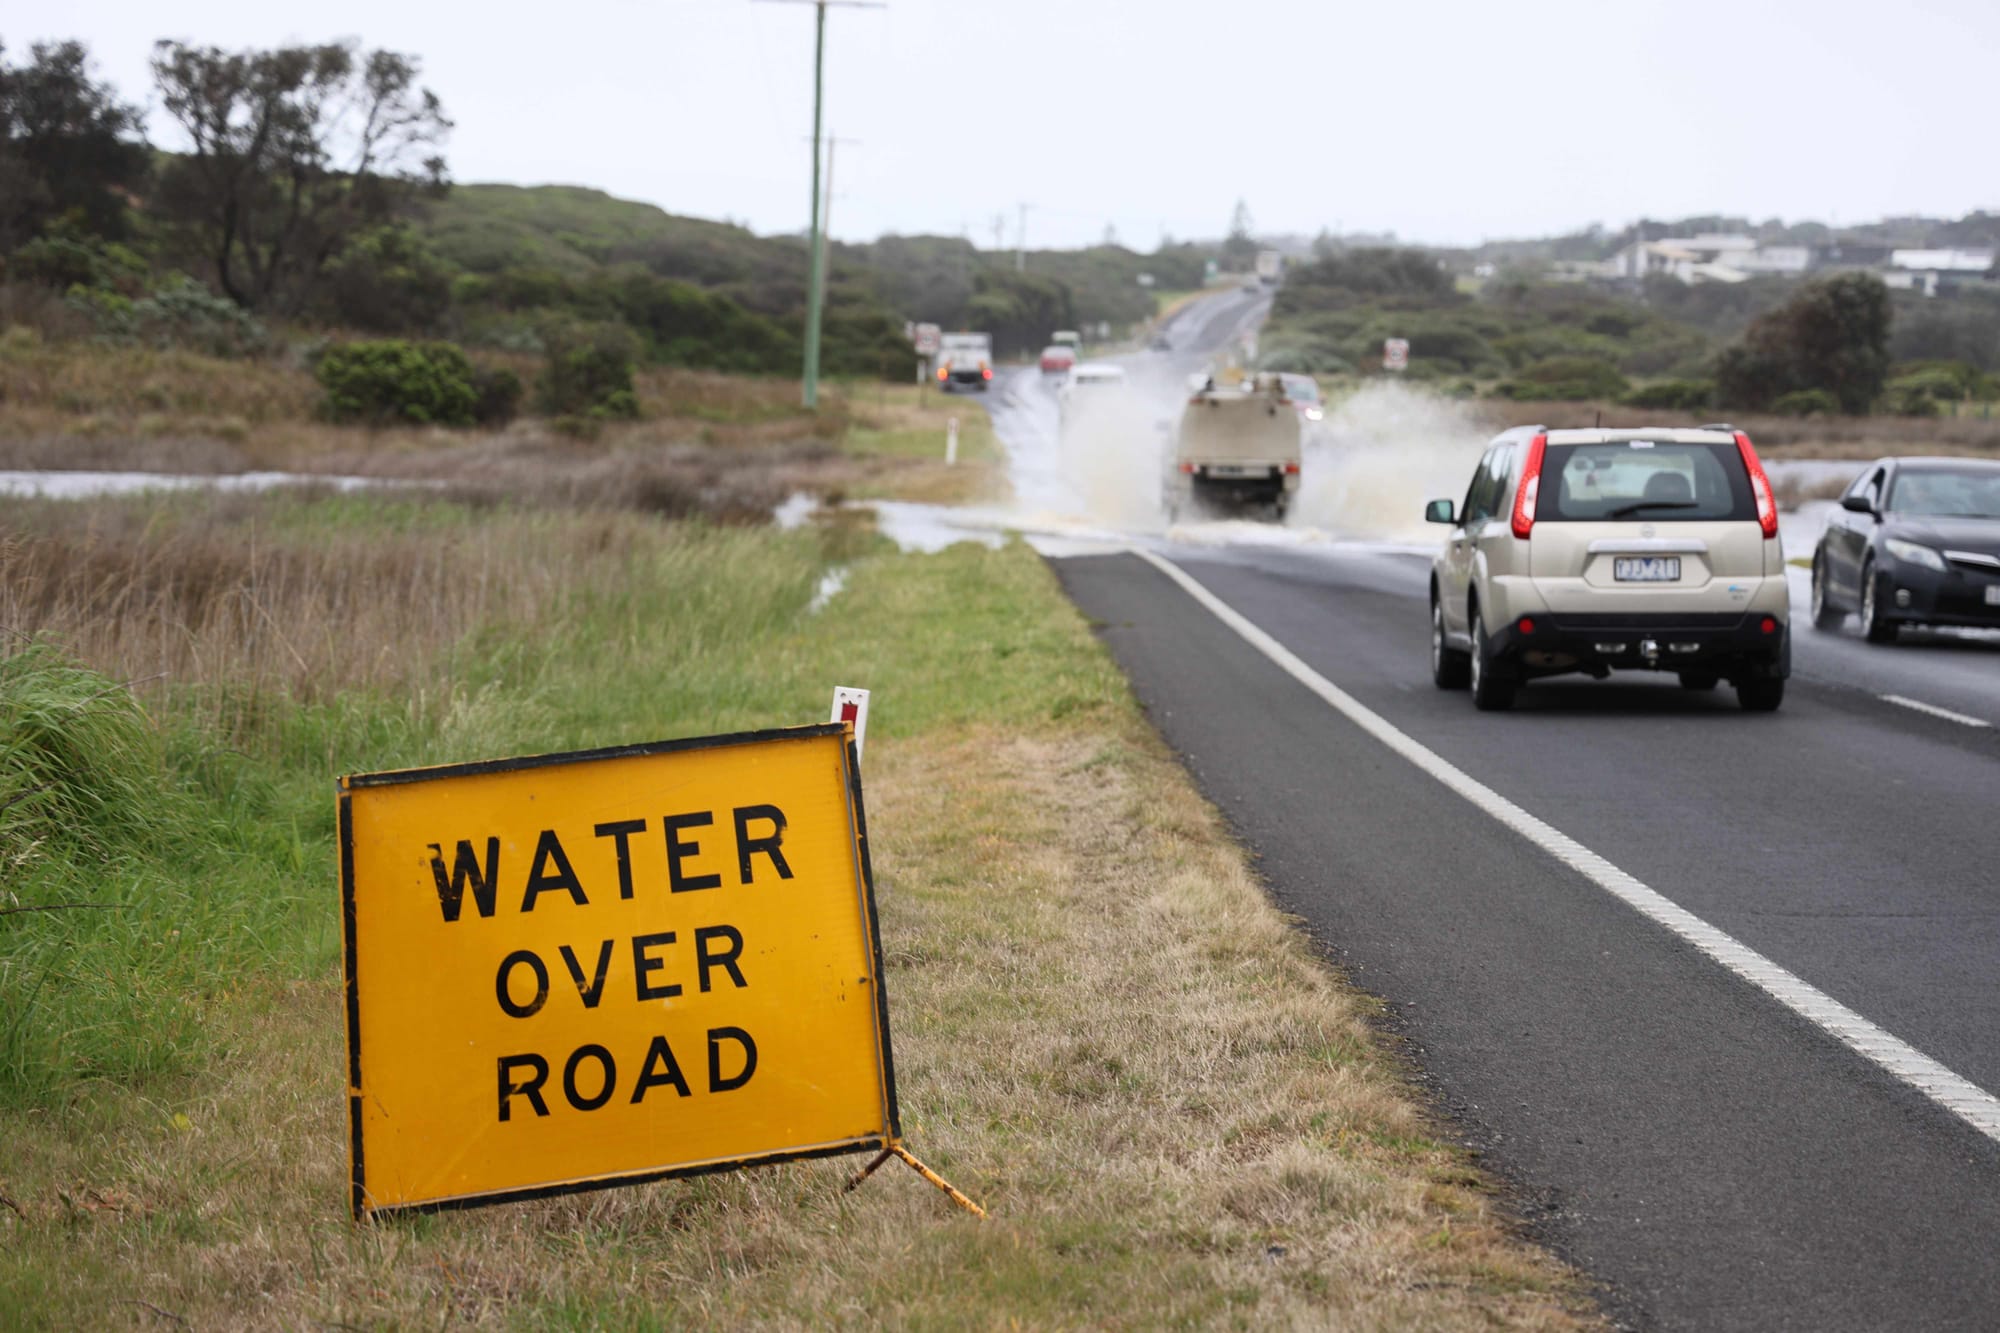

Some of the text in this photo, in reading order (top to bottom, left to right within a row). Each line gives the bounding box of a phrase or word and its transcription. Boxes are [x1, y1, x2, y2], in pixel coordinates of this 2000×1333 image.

[428, 804, 793, 922] WATER
[496, 924, 748, 1018] OVER
[498, 1027, 757, 1122] ROAD
